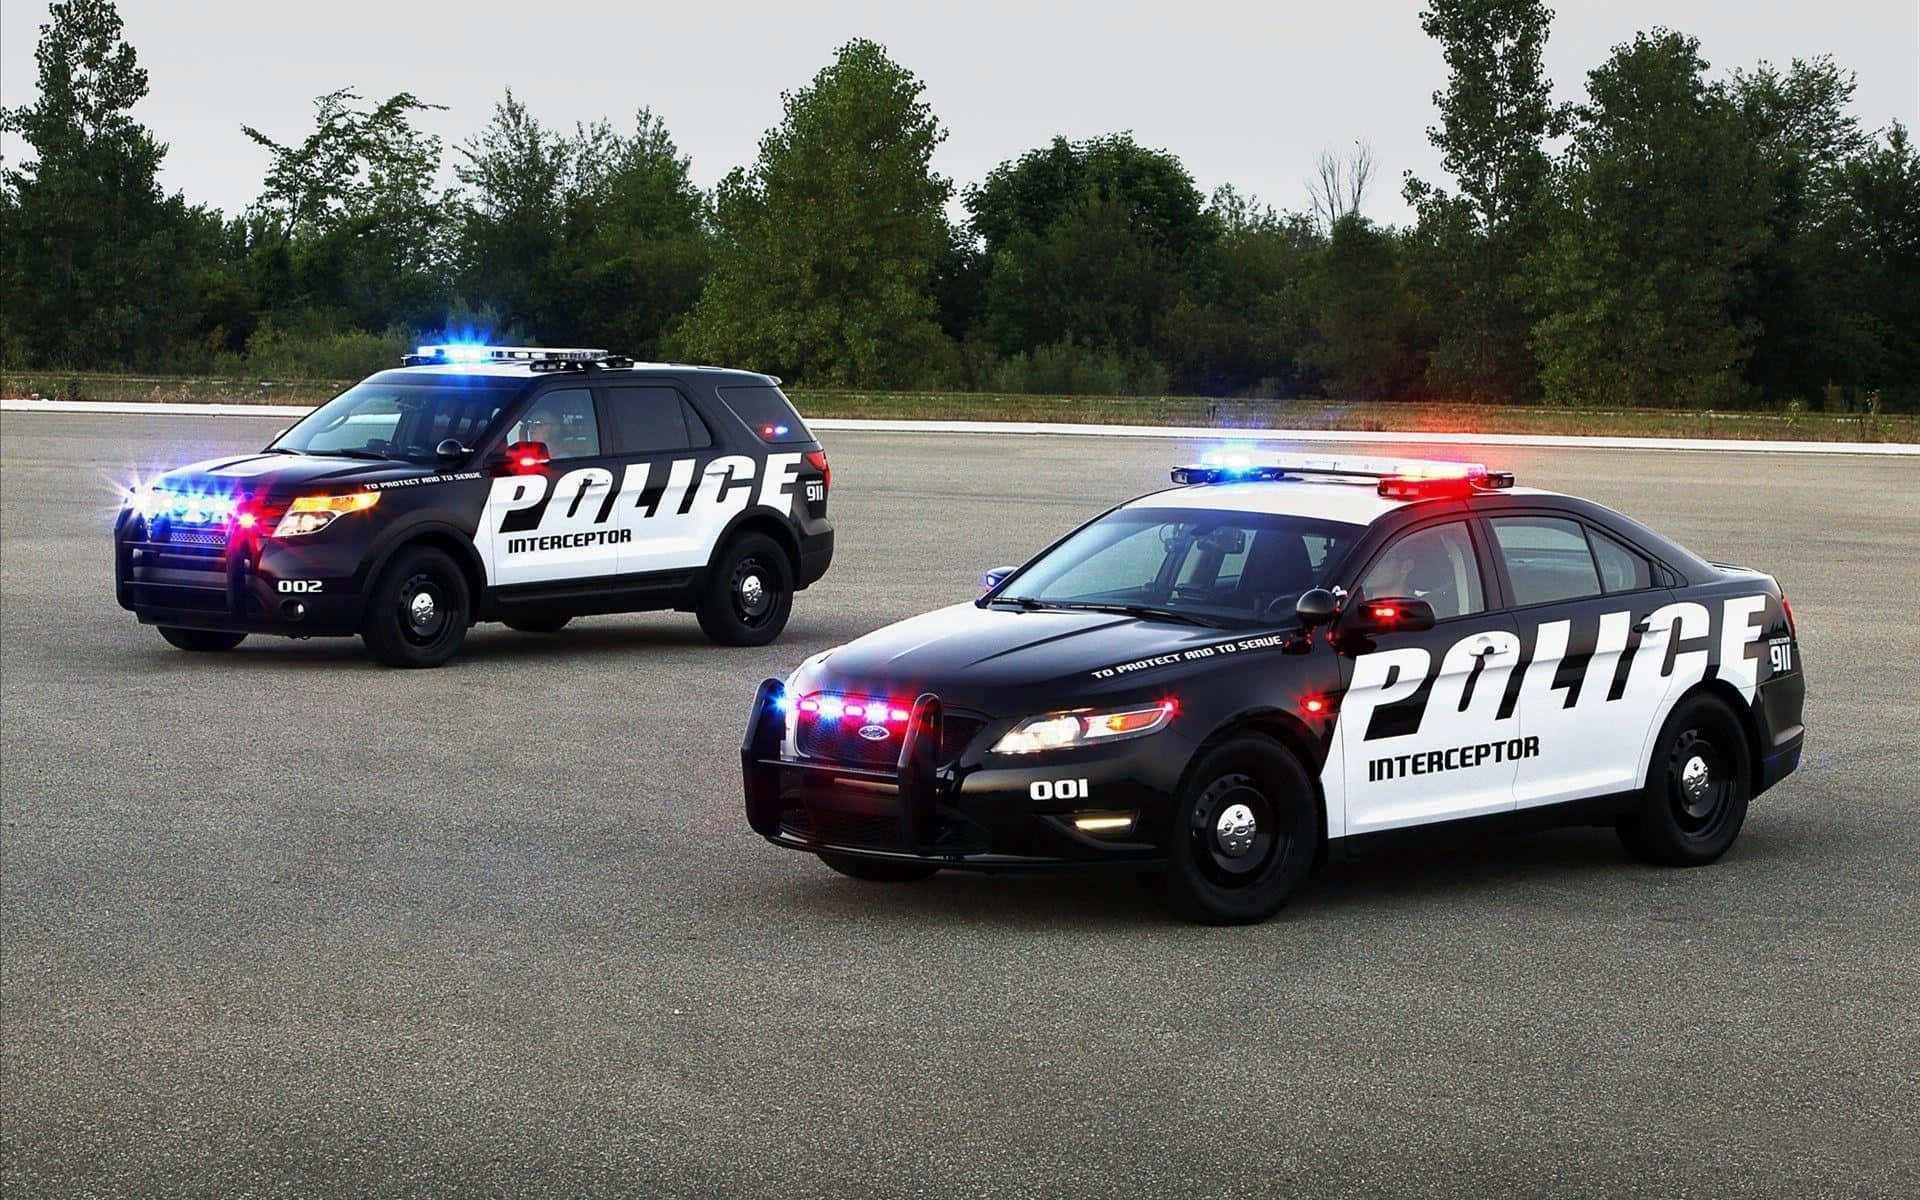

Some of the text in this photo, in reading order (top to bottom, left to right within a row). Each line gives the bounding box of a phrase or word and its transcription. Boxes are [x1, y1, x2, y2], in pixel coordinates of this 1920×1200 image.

[380, 478, 420, 488] PROTECT
[421, 475, 440, 484] AND
[454, 472, 482, 480] SERVE
[806, 485, 823, 501] 911
[482, 453, 802, 535] POLICE
[508, 529, 632, 553] INTERCEPTOR
[277, 580, 323, 593] 002
[1091, 635, 1283, 680] TO PROTECT AND TO SERVE
[1342, 595, 1766, 741] POLICE
[1770, 644, 1792, 671] 911
[1368, 735, 1539, 781] INTERCEPTOR
